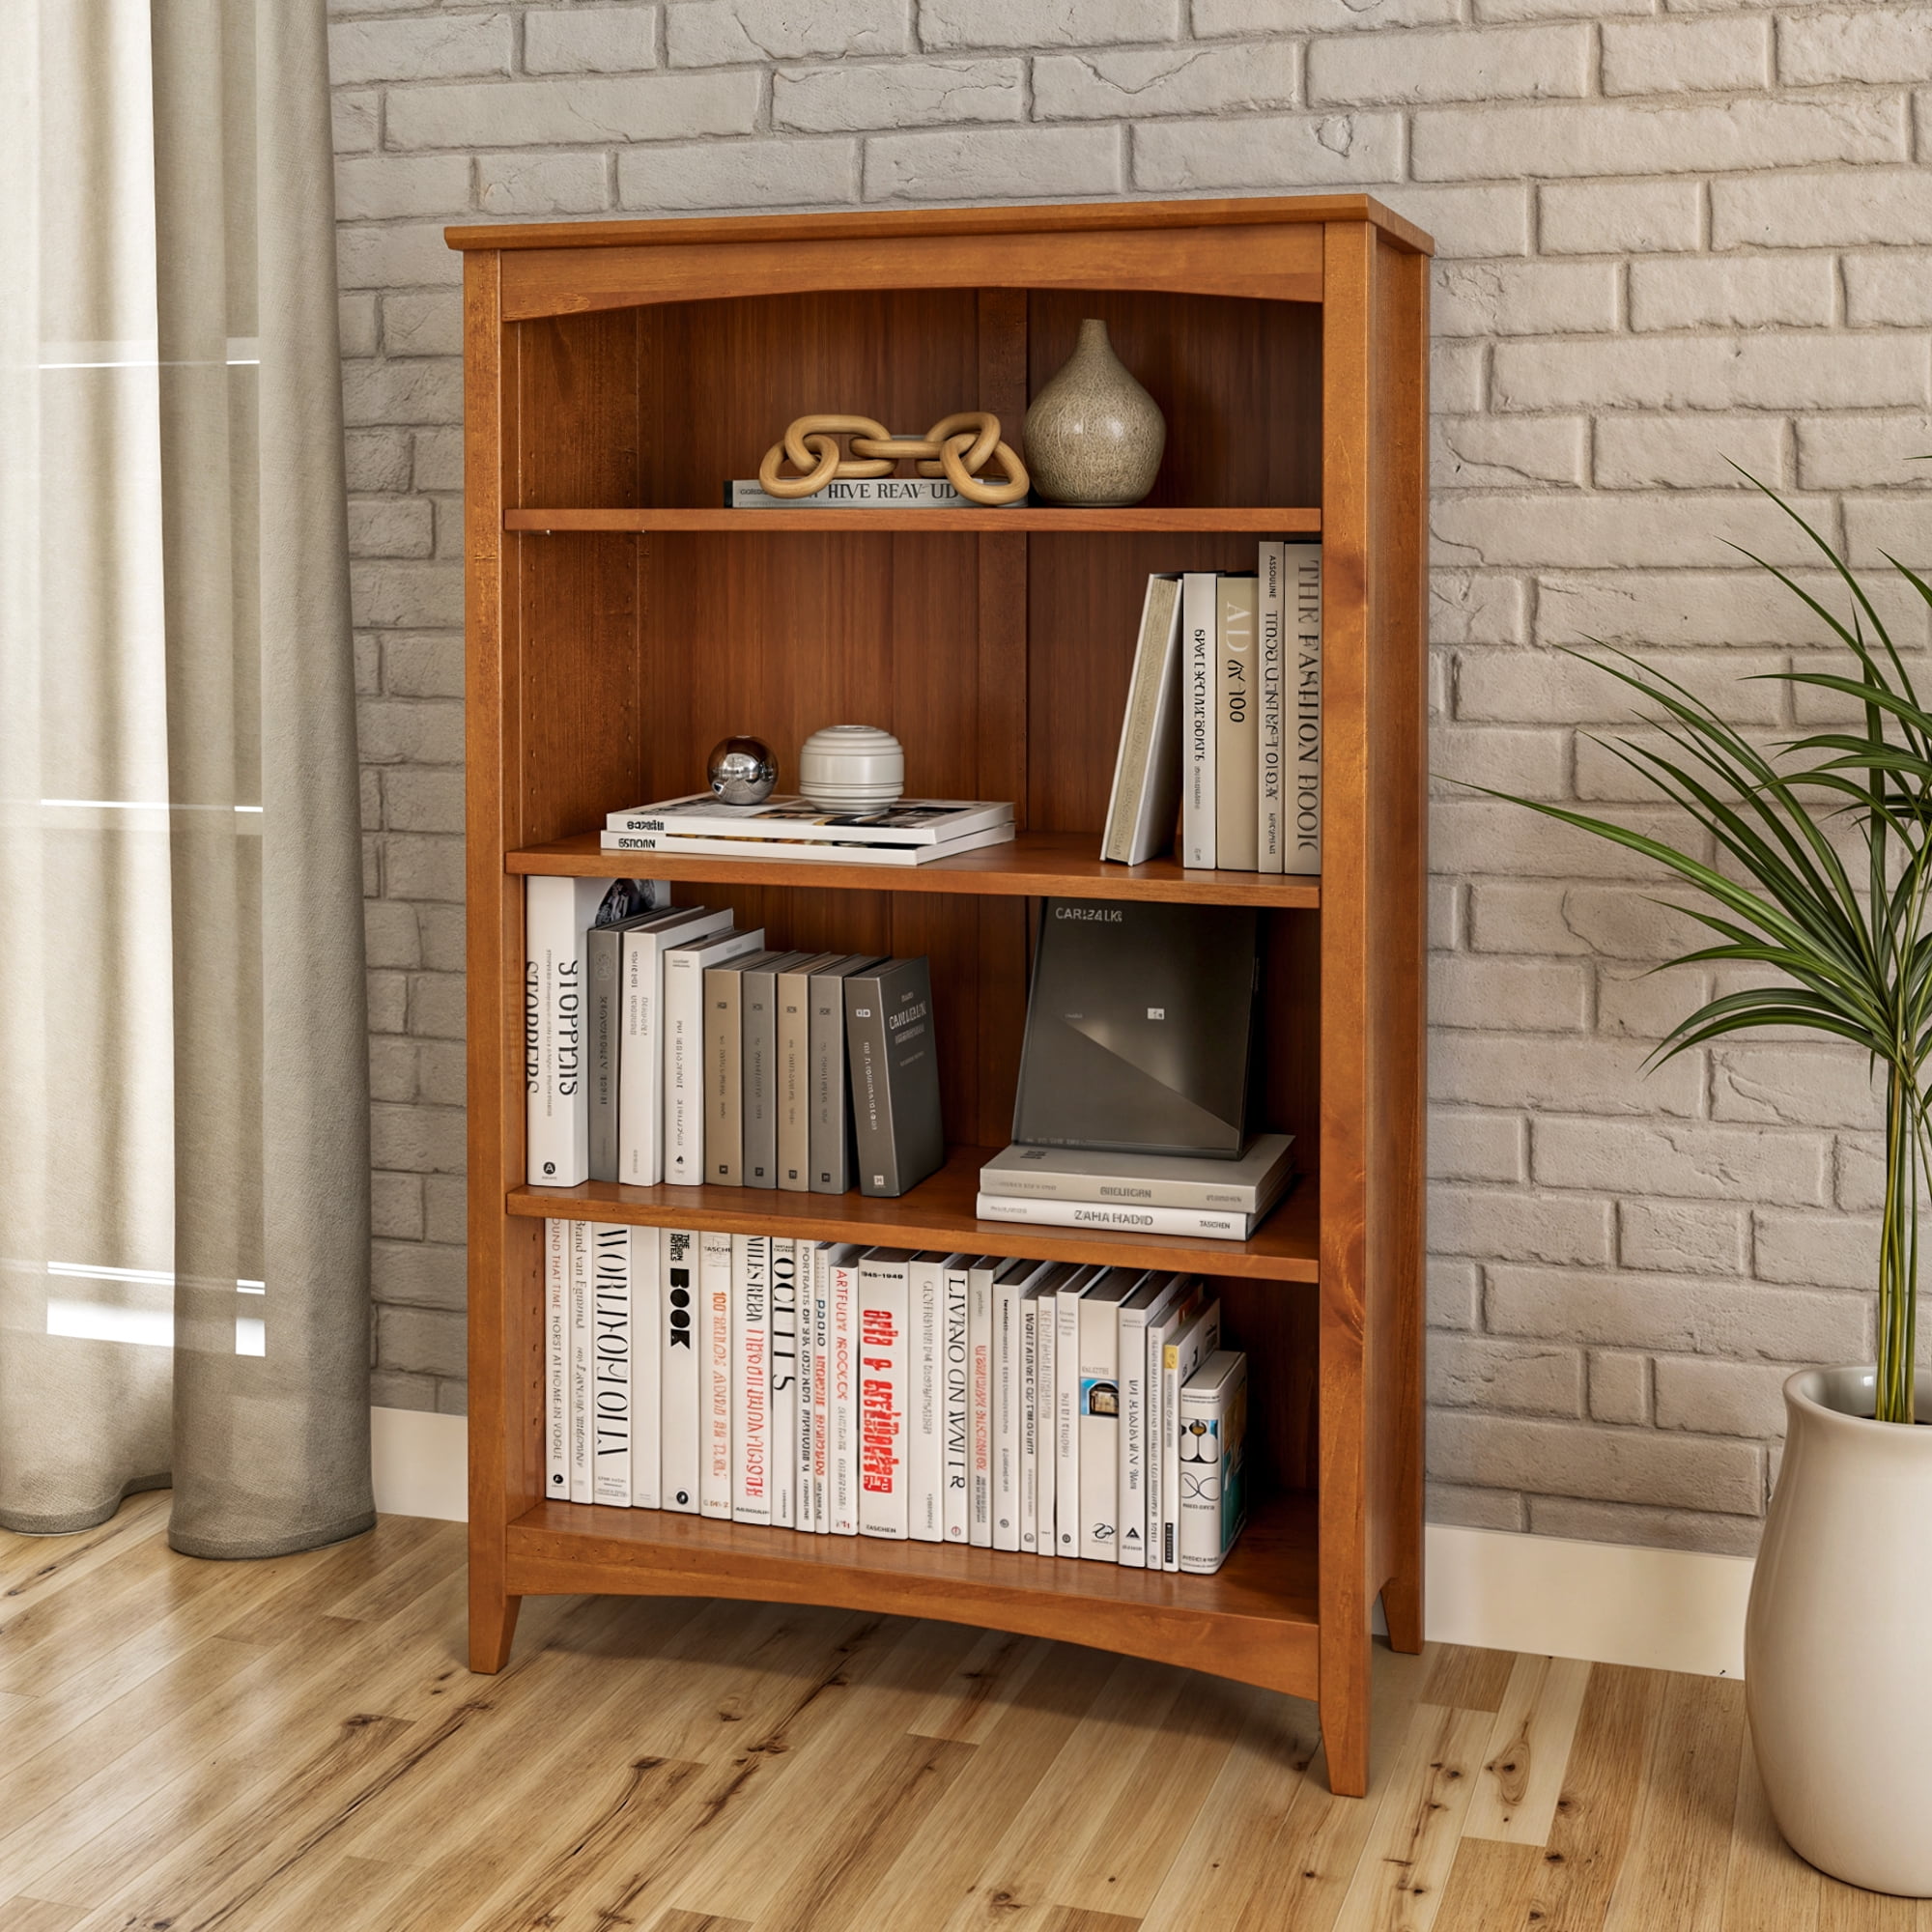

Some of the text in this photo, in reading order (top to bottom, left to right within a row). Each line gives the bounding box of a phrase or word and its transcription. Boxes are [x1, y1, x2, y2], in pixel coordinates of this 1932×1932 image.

[1074, 1209, 1110, 1223] ZAHA
[1200, 1220, 1230, 1229] TASCHEN
[553, 1285, 561, 1309] TIME
[713, 1292, 726, 1312] 100
[670, 1268, 691, 1350] BOOK
[553, 1316, 562, 1351] HORST
[553, 1354, 561, 1367] AT
[553, 1423, 562, 1460] VOGUE
